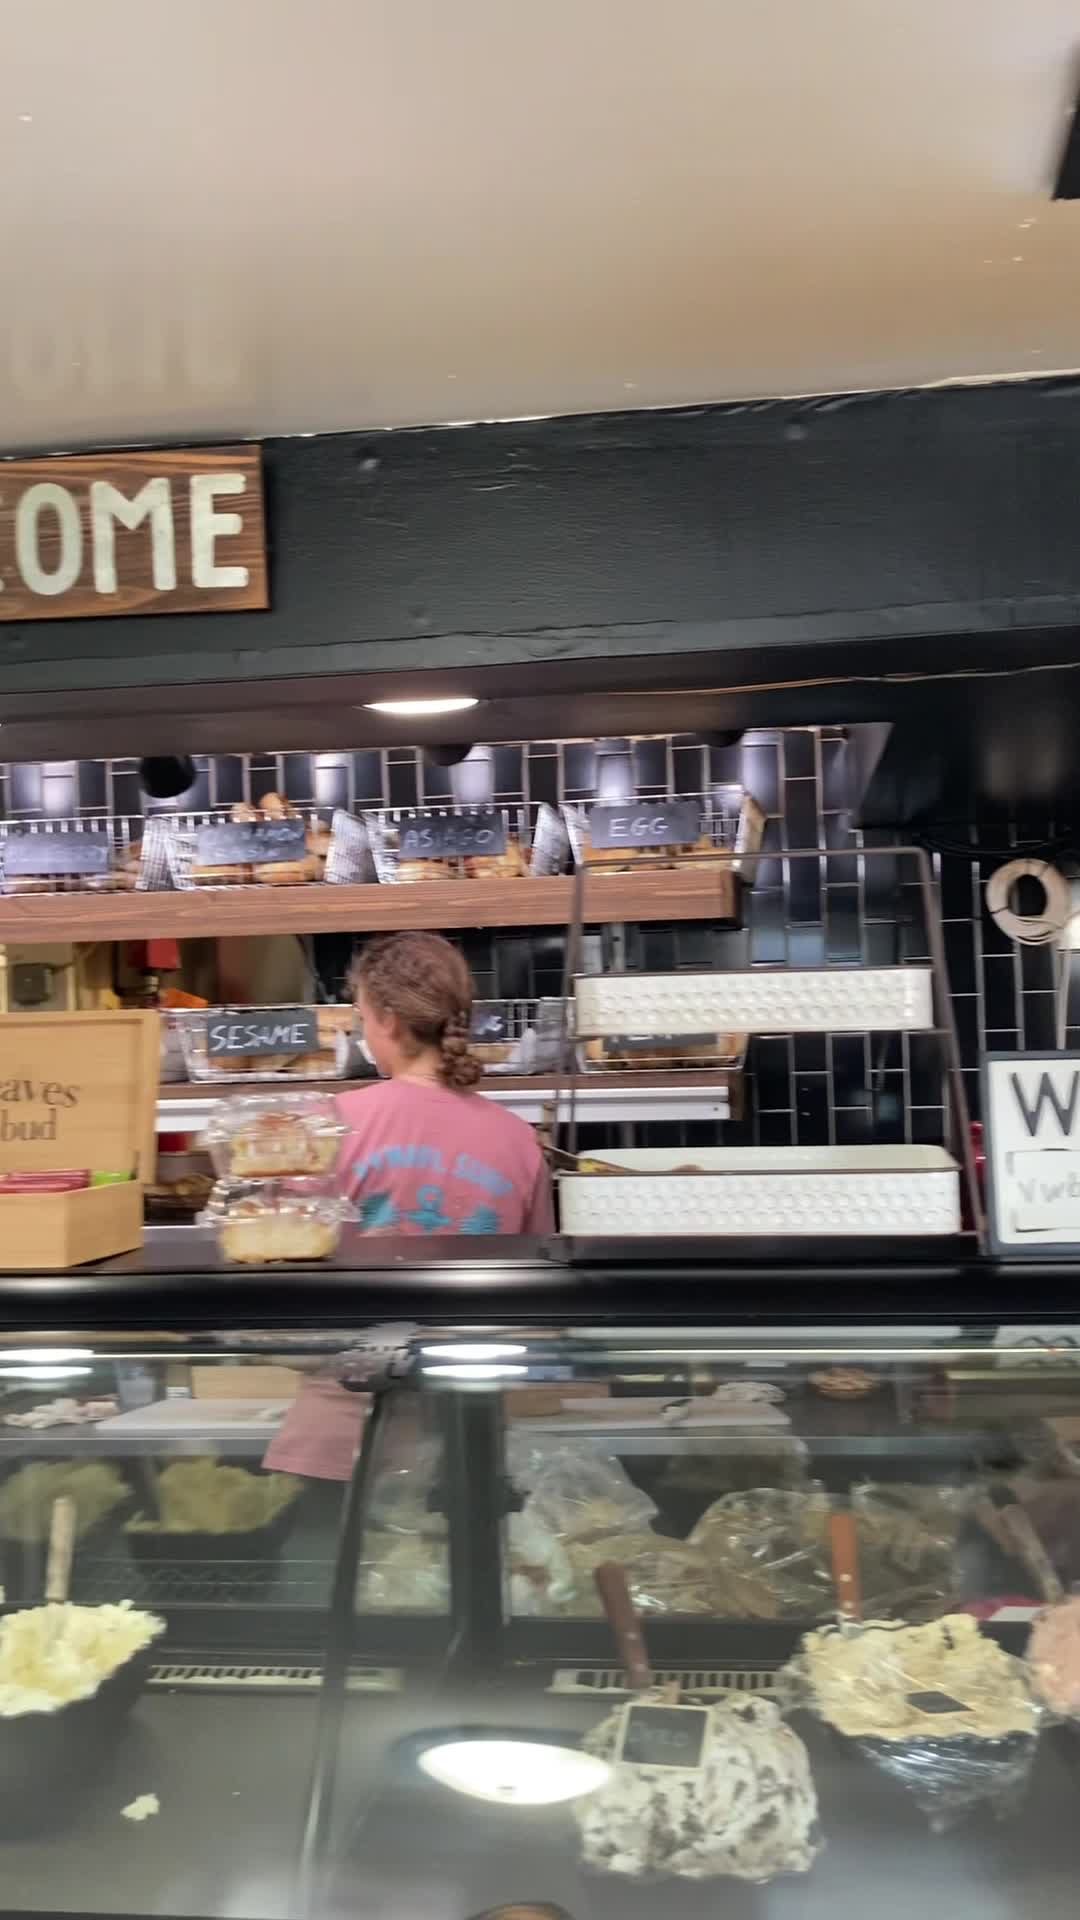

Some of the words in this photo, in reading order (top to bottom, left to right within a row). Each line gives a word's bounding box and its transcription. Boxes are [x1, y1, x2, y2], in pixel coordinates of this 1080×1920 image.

[0, 473, 249, 596] OME
[609, 817, 669, 837] EGG
[209, 1023, 310, 1051] SESAME
